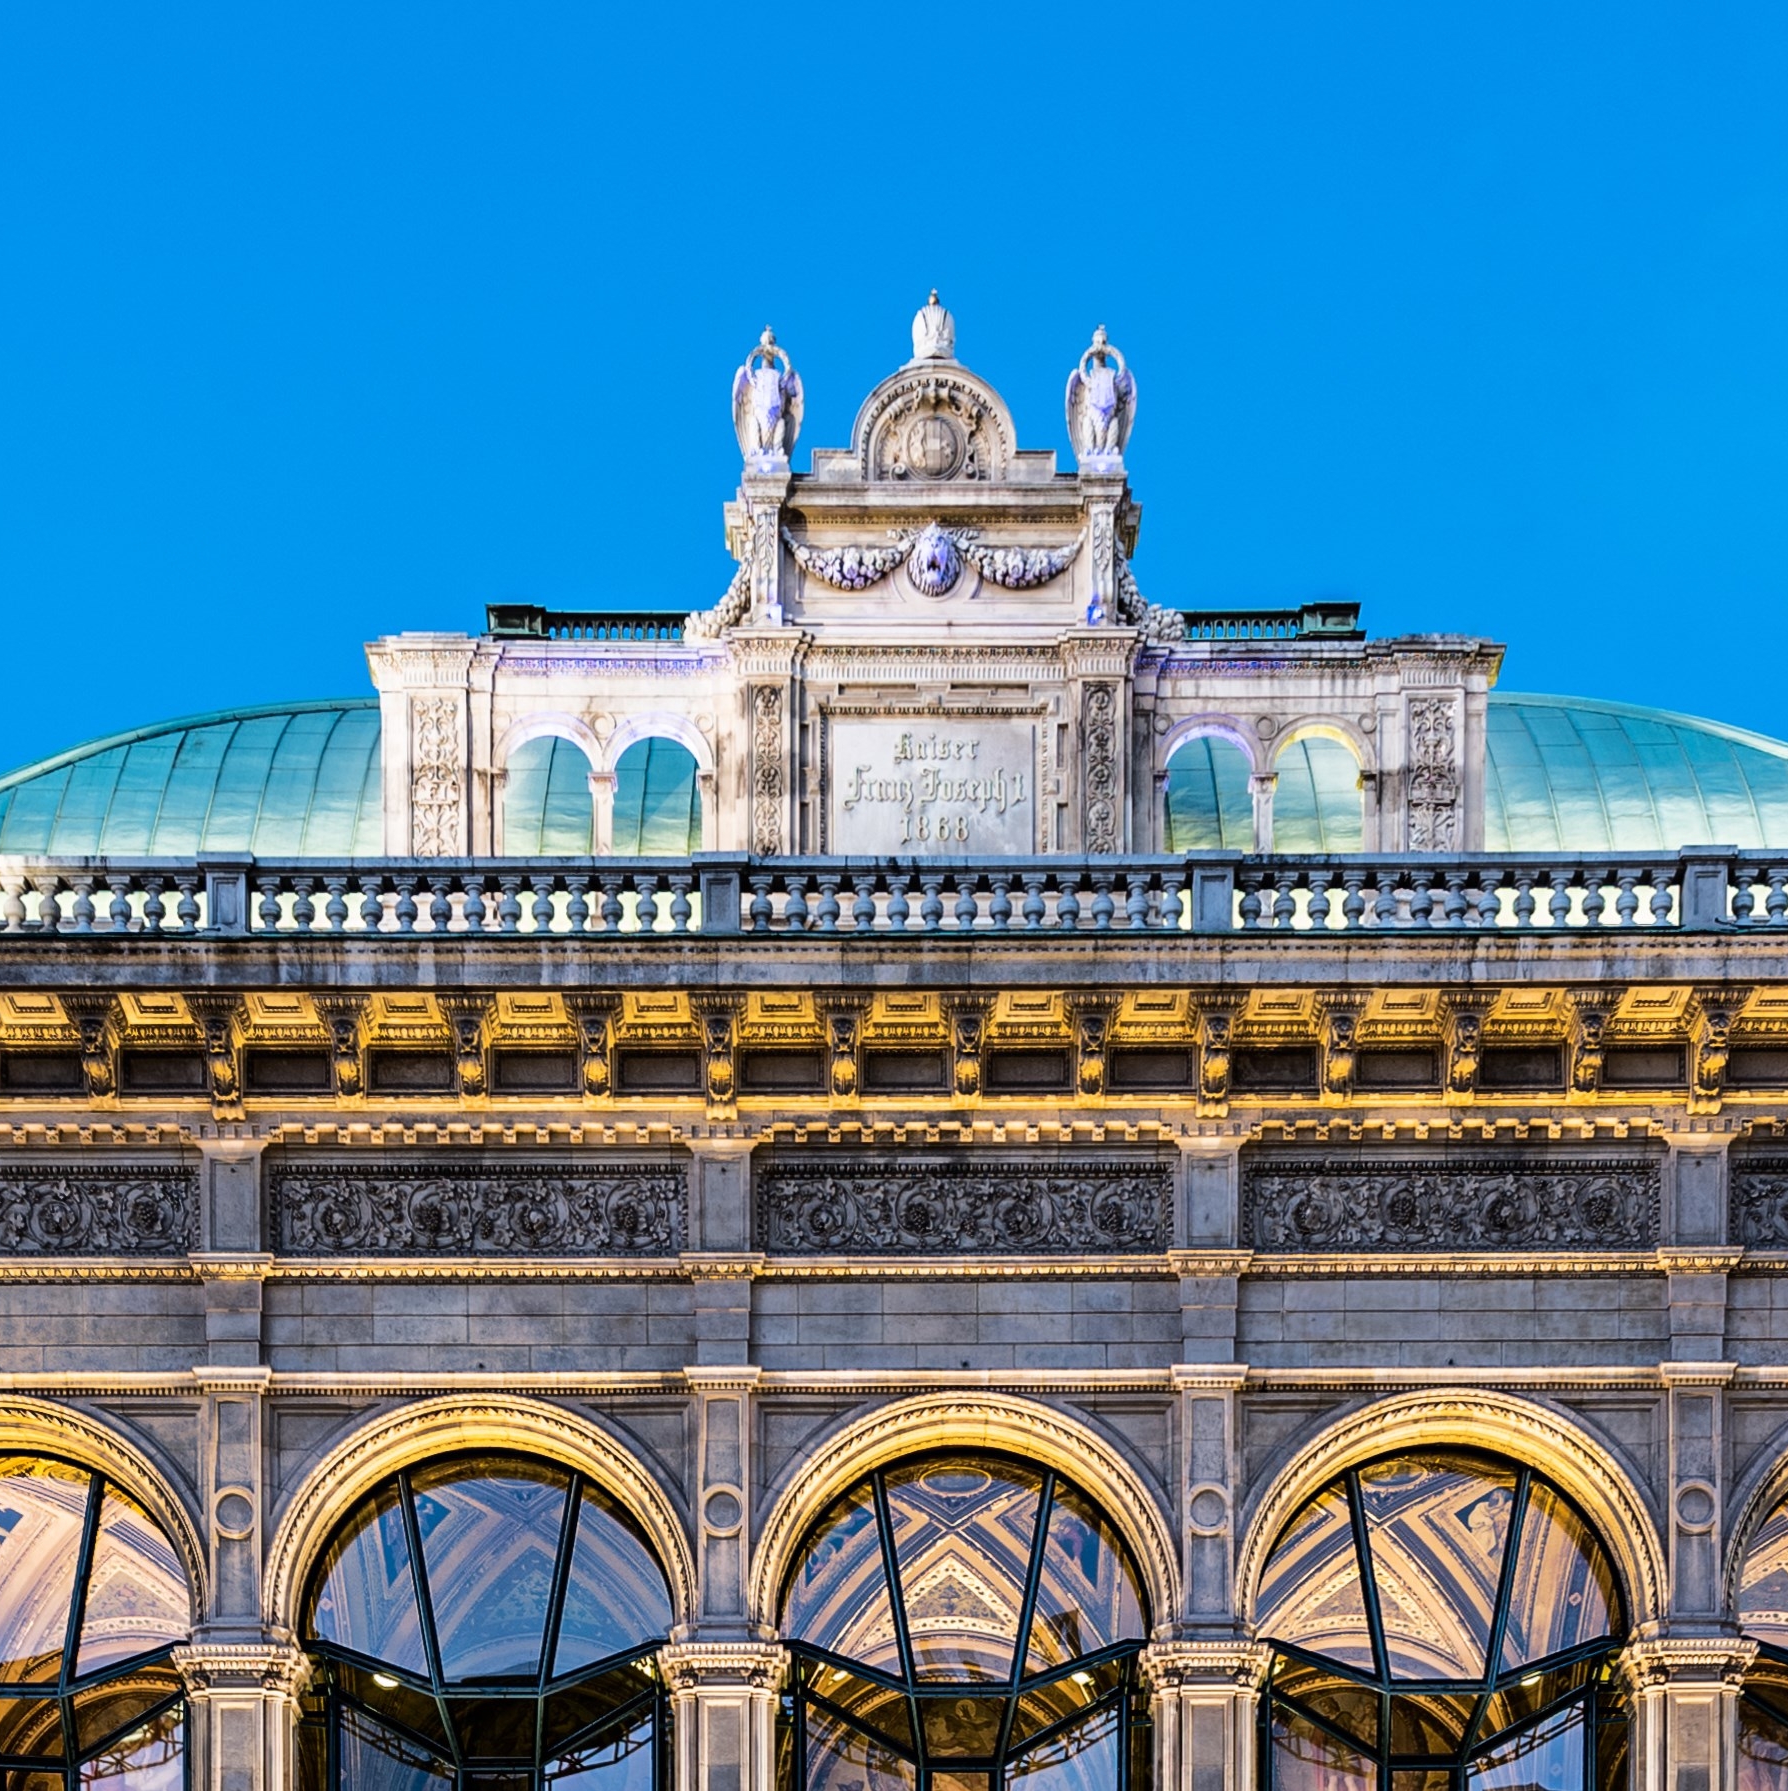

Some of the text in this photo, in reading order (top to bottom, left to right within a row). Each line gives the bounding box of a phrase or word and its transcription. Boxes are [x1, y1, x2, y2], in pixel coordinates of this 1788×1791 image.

[894, 732, 980, 764] Kaiser
[843, 765, 914, 813] Franz
[920, 766, 1007, 814] Joseph
[901, 816, 970, 845] 1868
